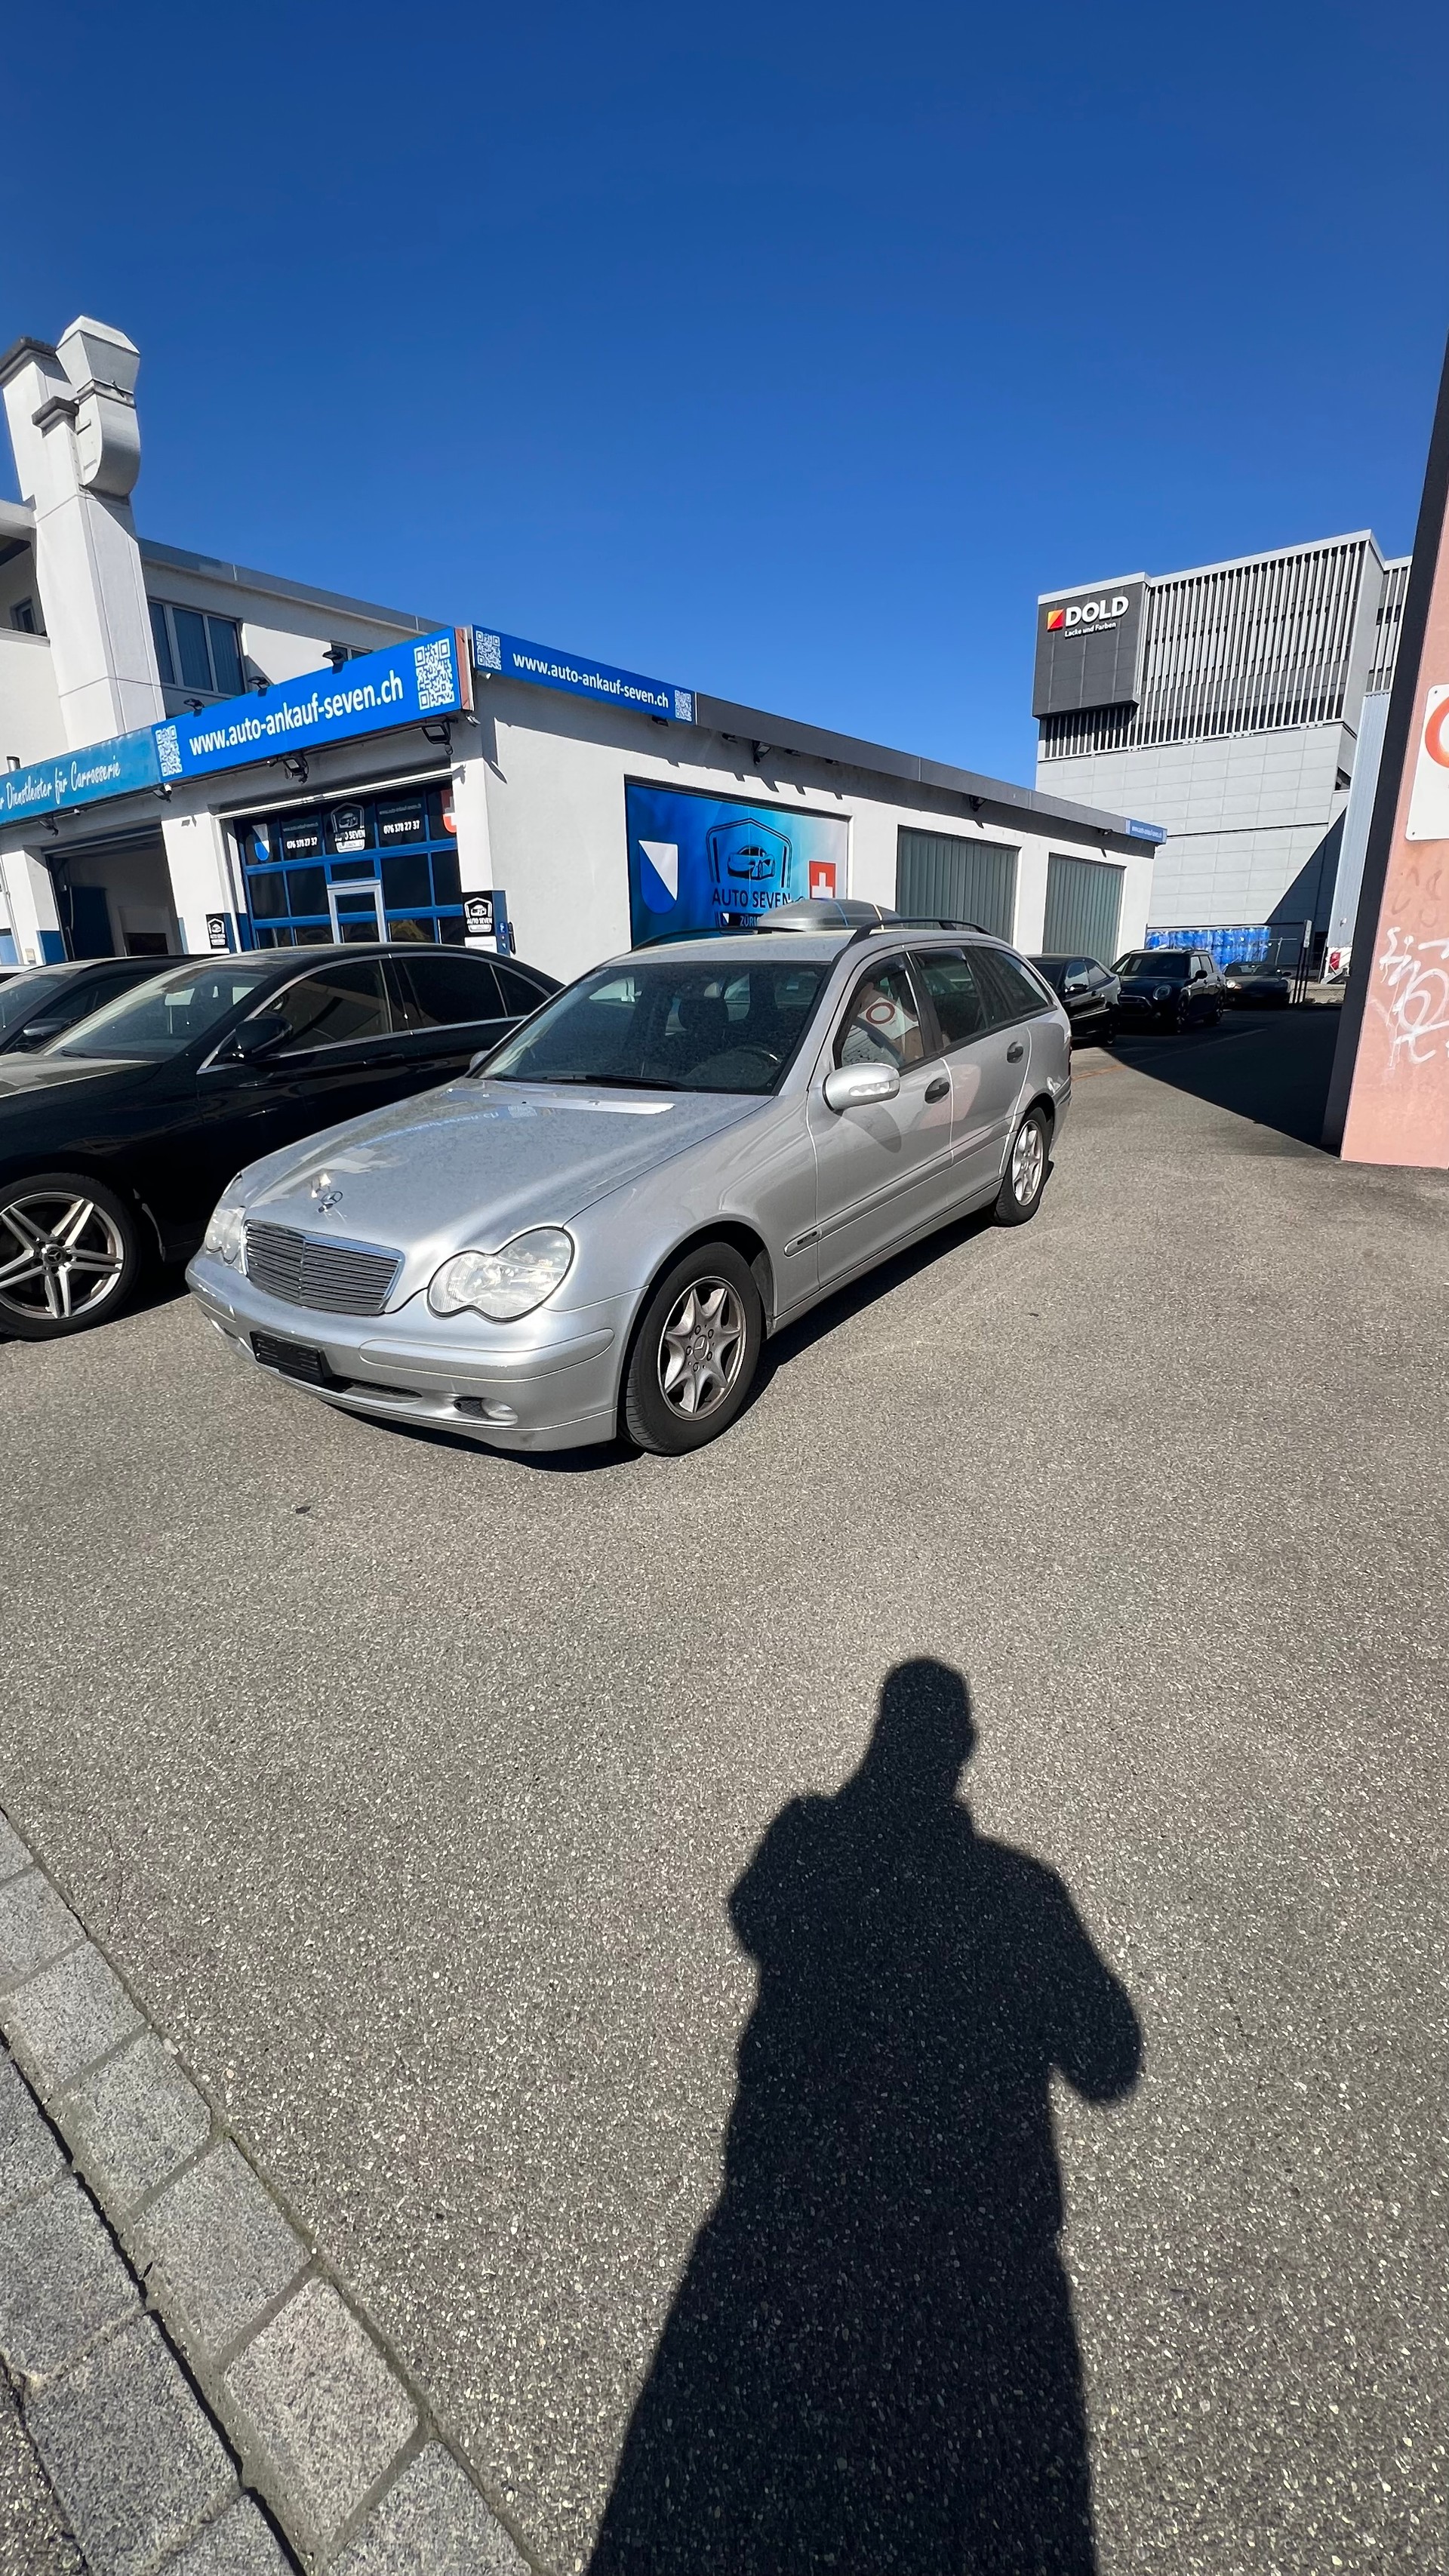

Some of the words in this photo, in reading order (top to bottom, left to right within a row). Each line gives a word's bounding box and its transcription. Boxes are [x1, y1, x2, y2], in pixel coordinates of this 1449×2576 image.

[1065, 596, 1129, 627] DOLD
[1064, 629, 1081, 638] Lacke
[1082, 624, 1094, 633] und
[1095, 622, 1117, 632] Farben
[512, 653, 669, 708] www.auto-ankauf-seven.ch
[189, 669, 404, 756] www.auto-ankauf-seven.ch
[6, 775, 52, 810] Dienstleister
[54, 767, 68, 805] für
[70, 755, 122, 792] Carrosserie
[349, 829, 366, 840] SEVEN
[383, 824, 394, 834] 076
[404, 820, 412, 833] 27
[412, 820, 420, 830] 37
[712, 888, 749, 906] AUTO
[752, 891, 791, 909] SEVEN
